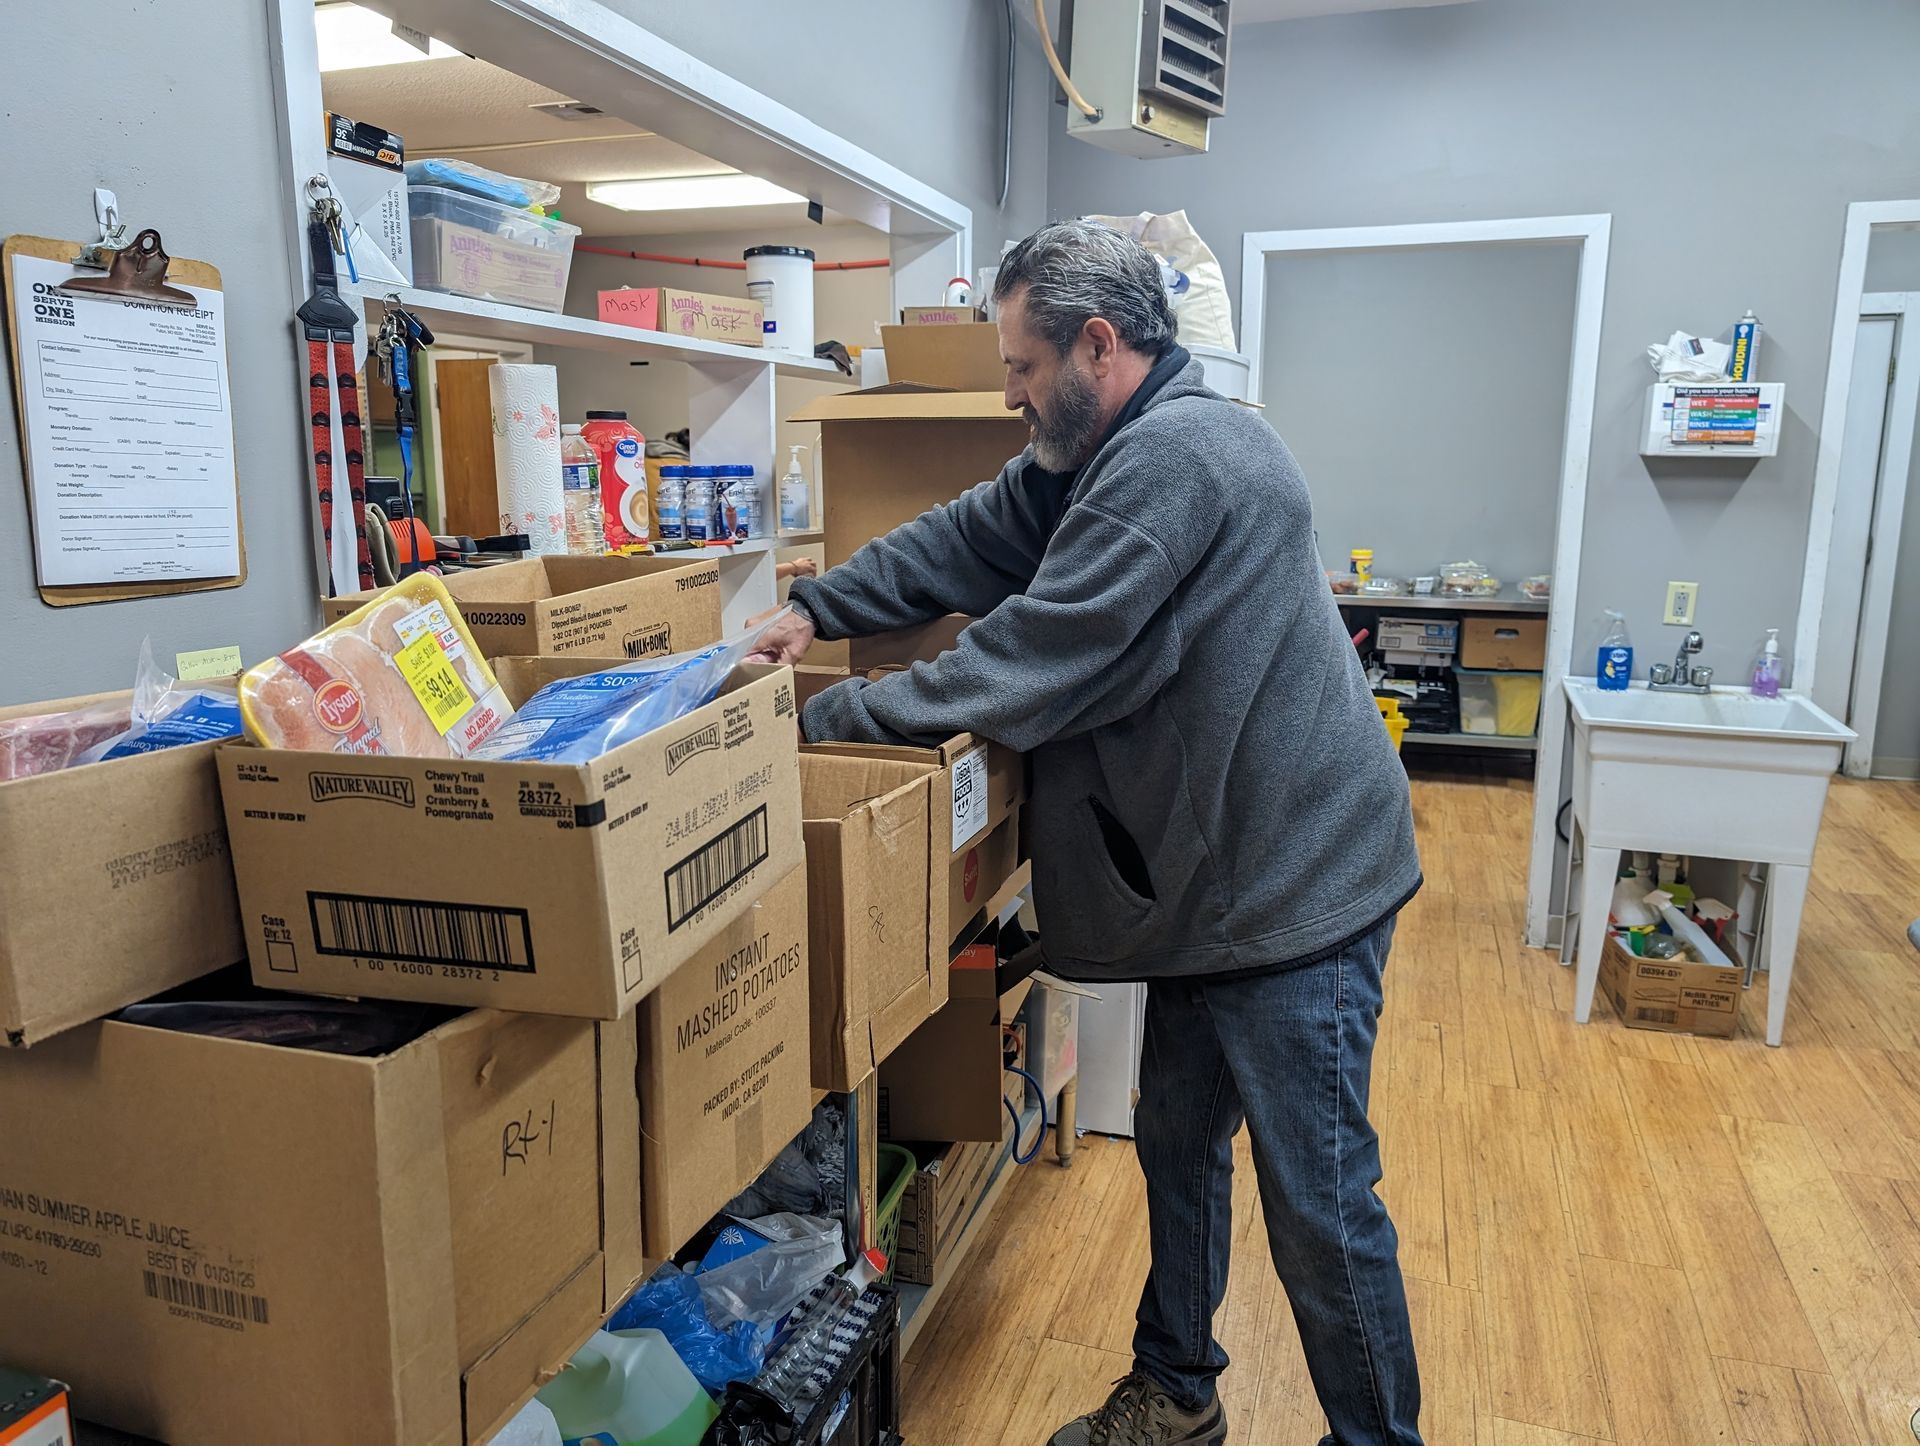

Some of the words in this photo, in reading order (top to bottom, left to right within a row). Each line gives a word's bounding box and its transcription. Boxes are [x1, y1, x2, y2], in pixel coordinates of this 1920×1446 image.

[335, 127, 348, 140] 36
[32, 282, 72, 298] ON
[33, 295, 74, 308] SERVE
[671, 296, 704, 314] Annie's
[34, 304, 75, 320] ONE
[176, 307, 214, 320] RECEIPT
[35, 316, 76, 328] MISSION
[675, 570, 719, 592] 7910022309
[464, 612, 527, 626] 10022309
[551, 618, 570, 629] Dipped
[570, 616, 587, 625] Biscuit
[588, 610, 601, 620] Baked
[602, 608, 612, 616] With
[613, 604, 628, 614] Yogurt
[564, 629, 572, 638] OZ
[589, 618, 612, 630] POUCHES
[553, 643, 564, 652] NET
[565, 641, 574, 650] WT
[578, 638, 585, 646] LB
[410, 652, 425, 670] SAVE
[426, 667, 455, 699] $9.14
[319, 690, 358, 725] Tyson
[723, 704, 740, 718] Chewy
[739, 699, 750, 710] Trail
[464, 726, 477, 740] NO
[475, 708, 495, 727] ADDED
[727, 718, 736, 728] Mix
[737, 712, 748, 723] Bars
[724, 723, 748, 740] Cranberry
[668, 743, 695, 771] NATURE
[695, 726, 719, 750] VALLEY
[724, 730, 754, 751] Pomegranate
[425, 770, 461, 785] Chewy
[461, 771, 485, 784] Trail
[956, 766, 970, 782] USDA
[314, 776, 364, 798] NATURE
[365, 777, 410, 804] VALLEY
[433, 783, 452, 794] Mix
[454, 784, 480, 796] Bars
[518, 790, 562, 806] 28372
[426, 795, 478, 810] Cranberry
[481, 798, 490, 809] &
[244, 810, 269, 820] BETTER
[278, 812, 295, 821] USED
[297, 813, 306, 822] BY
[425, 806, 494, 821] Pomegranate
[557, 820, 574, 830] 000
[695, 911, 704, 924] 00
[707, 893, 728, 914] 16000
[730, 875, 748, 897] 28372
[261, 914, 286, 928] Case
[264, 927, 280, 942] Qty:
[282, 929, 292, 941] 12
[620, 928, 636, 945] Case
[632, 936, 639, 948] 12
[353, 959, 359, 969] 1
[368, 960, 384, 971] 00
[393, 962, 433, 976] 16000
[442, 966, 483, 980] 28372
[492, 971, 500, 982] 2
[715, 932, 770, 992] INSTANT
[677, 988, 738, 1054] MASHED
[743, 942, 800, 1007] POTATOES
[1692, 999, 1720, 1008] PATTIES
[705, 1033, 733, 1059] Material
[734, 1018, 754, 1037] Code:
[755, 997, 777, 1022] 100337
[703, 1086, 729, 1116] PACKED
[729, 1080, 740, 1099] BY:
[740, 1061, 759, 1085] STUTZ
[760, 1041, 784, 1070] PACKING
[721, 1098, 742, 1122] INDIO,
[743, 1088, 751, 1103] CA
[752, 1073, 769, 1097] 92201
[27, 1194, 92, 1227] SUMMER
[95, 1210, 142, 1239] APPLE
[145, 1222, 190, 1250] JUICE
[147, 1250, 178, 1272] BEST
[182, 1258, 198, 1276] BY
